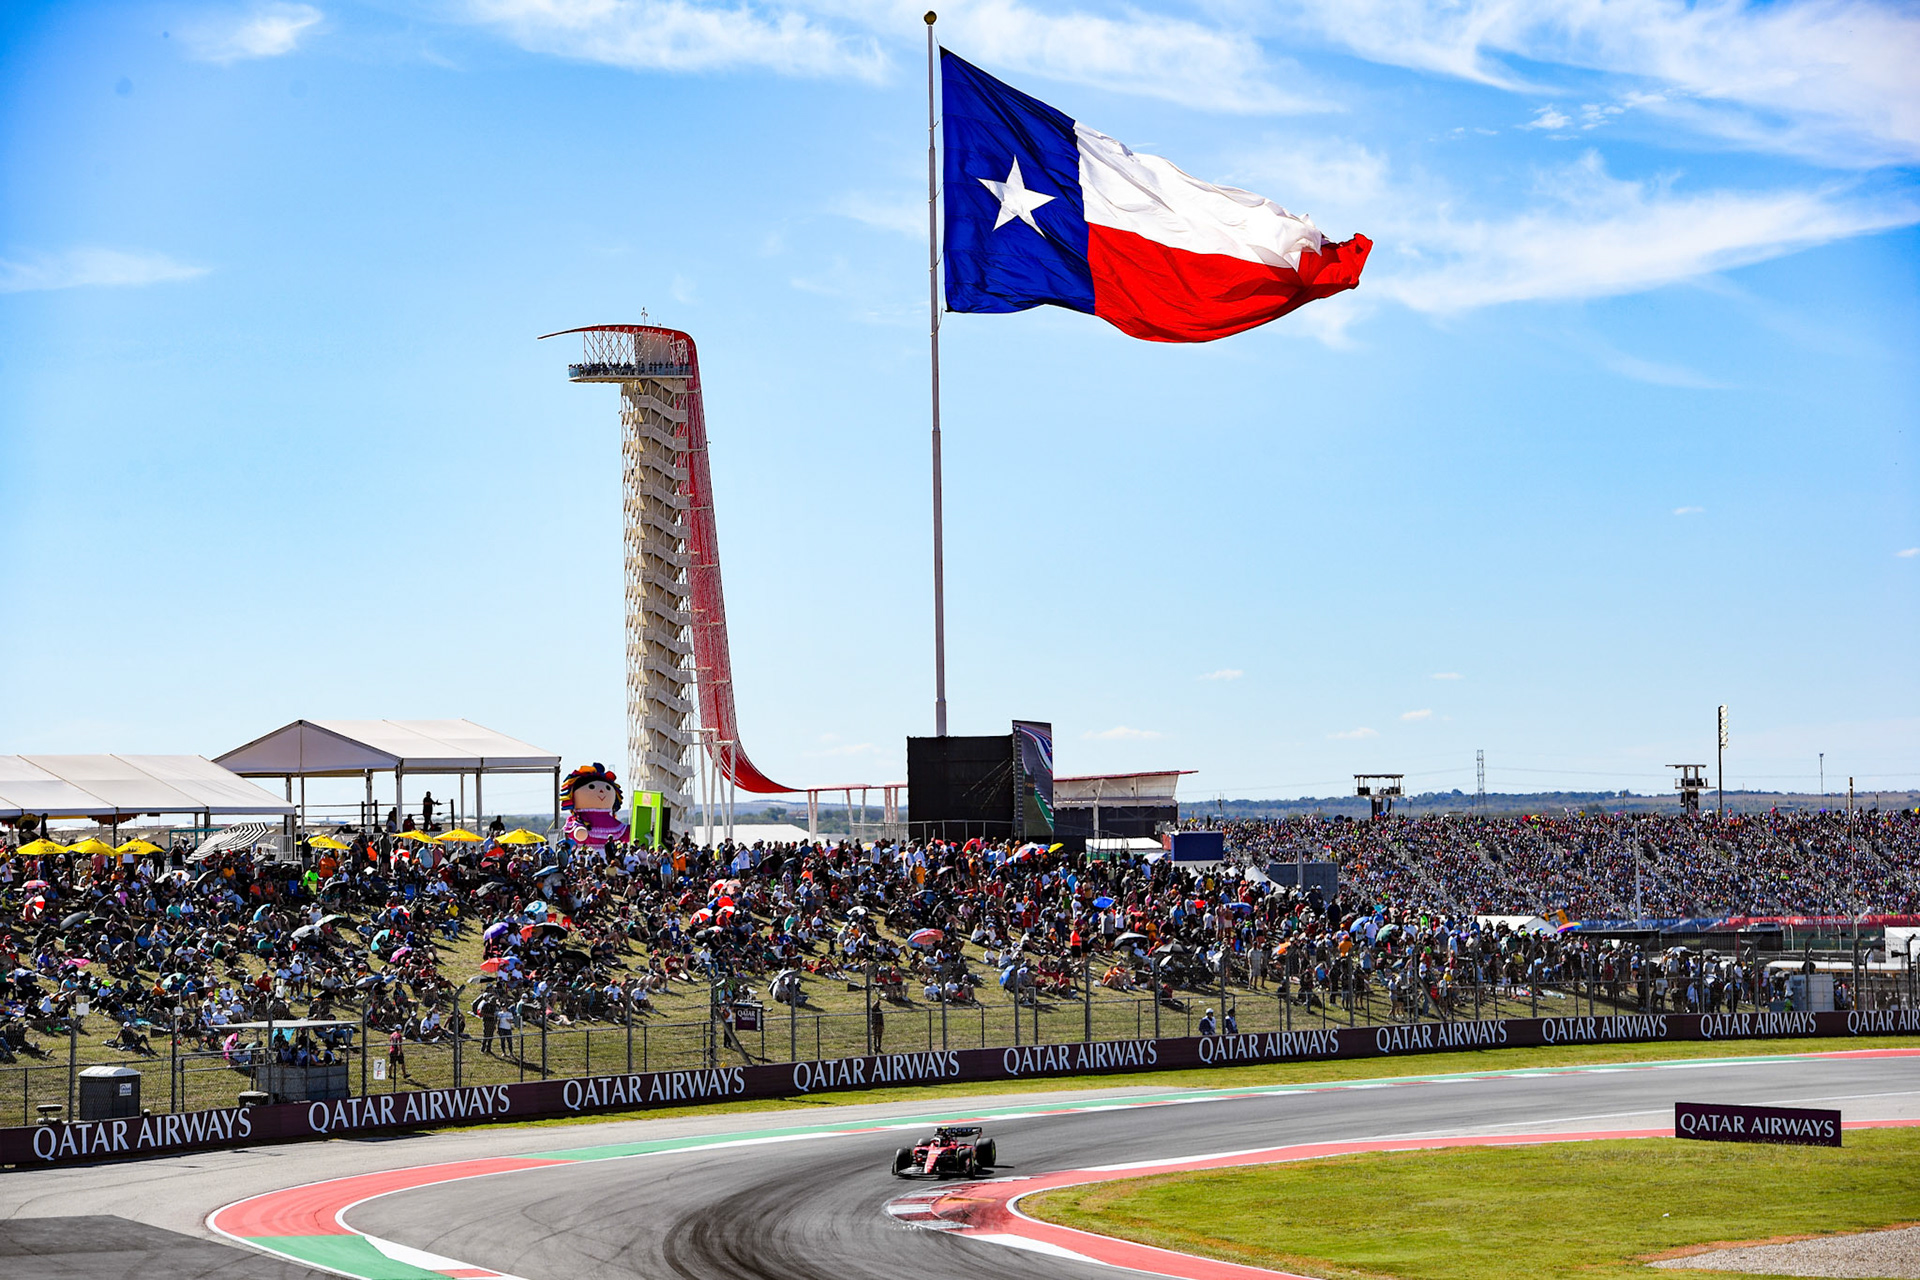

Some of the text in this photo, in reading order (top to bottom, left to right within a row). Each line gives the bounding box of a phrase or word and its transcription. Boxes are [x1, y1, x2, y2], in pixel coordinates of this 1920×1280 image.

[1376, 1020, 1507, 1053] QATAR AIRWAYS
[1542, 1014, 1667, 1043] QATAR AIRWAYS
[1700, 1012, 1817, 1038] QATAR AIRWAYS
[1847, 1010, 1895, 1034] QATAR
[1003, 1039, 1158, 1076] QATAR AIRWAYS
[1198, 1028, 1339, 1064] QATAR AIRWAYS
[563, 1066, 745, 1111] QATAR AIRWAYS
[793, 1050, 960, 1092] QATAR AIRWAYS
[308, 1086, 511, 1134] QATAR AIRWAYS
[1680, 1113, 1836, 1139] QATAR AIRWAYS
[33, 1107, 252, 1161] QATAR AIRWAYS
